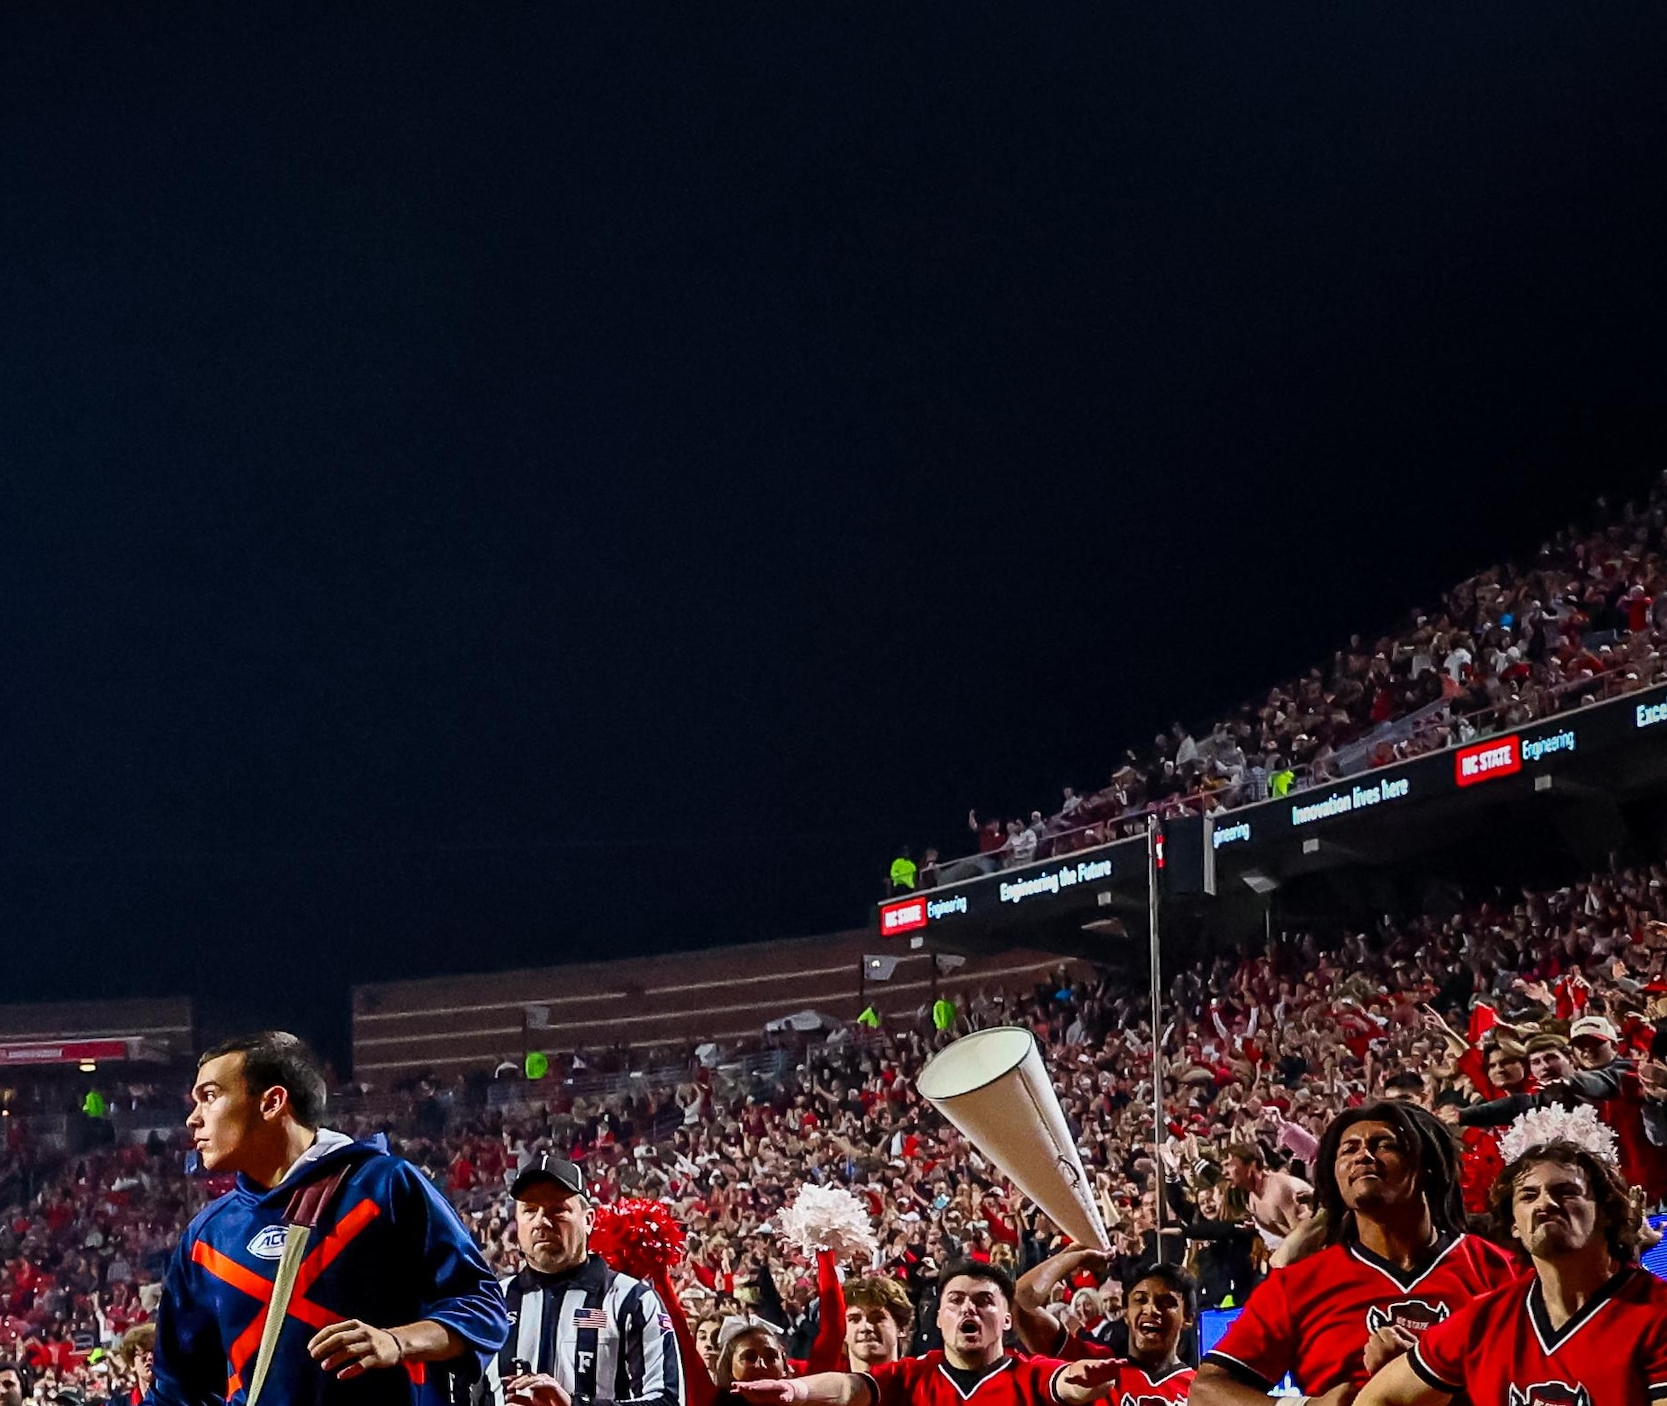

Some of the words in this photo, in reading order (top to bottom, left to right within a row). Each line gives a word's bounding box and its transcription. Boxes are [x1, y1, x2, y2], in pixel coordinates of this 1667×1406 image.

[1636, 700, 1667, 728] Exce
[1461, 756, 1479, 776] NC
[1478, 745, 1512, 772] STATE
[1522, 729, 1575, 761] Engineering
[1291, 792, 1352, 826] Innovation
[1352, 785, 1381, 810] lives
[1381, 777, 1410, 800] here
[1212, 820, 1251, 849] gineering
[999, 871, 1059, 903] Engineering
[1058, 865, 1078, 888] the
[1077, 860, 1112, 885] Future
[926, 894, 967, 920] Engineering
[577, 1351, 594, 1374] F
